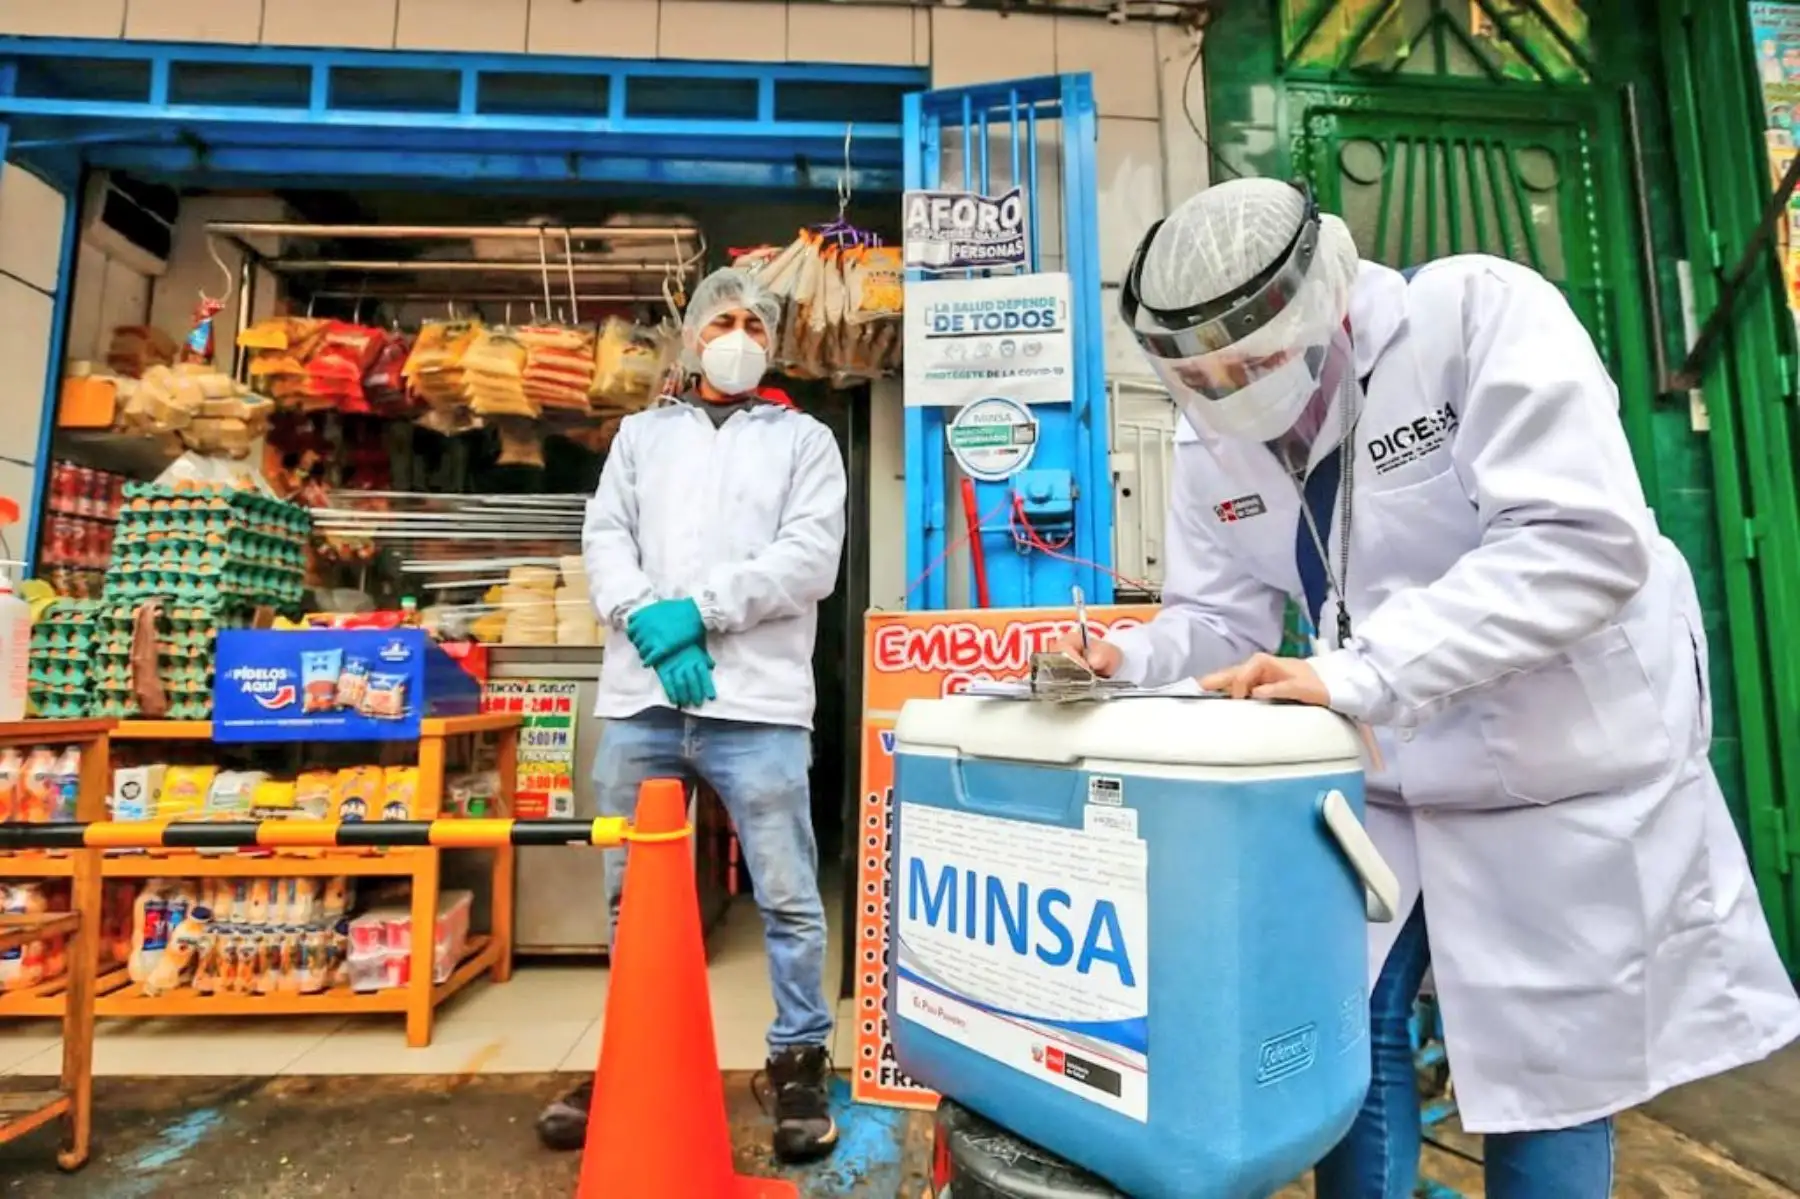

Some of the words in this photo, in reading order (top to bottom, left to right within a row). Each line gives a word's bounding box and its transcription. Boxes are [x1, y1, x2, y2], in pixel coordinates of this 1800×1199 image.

[907, 195, 1022, 232] AFORO
[951, 240, 1024, 259] PERSONAS
[934, 303, 950, 313] LA
[953, 301, 994, 312] SALUD
[997, 297, 1057, 310] DEPENDE
[934, 314, 965, 332] DE
[970, 310, 1056, 331] TODOS
[908, 856, 1136, 988] MINSA
